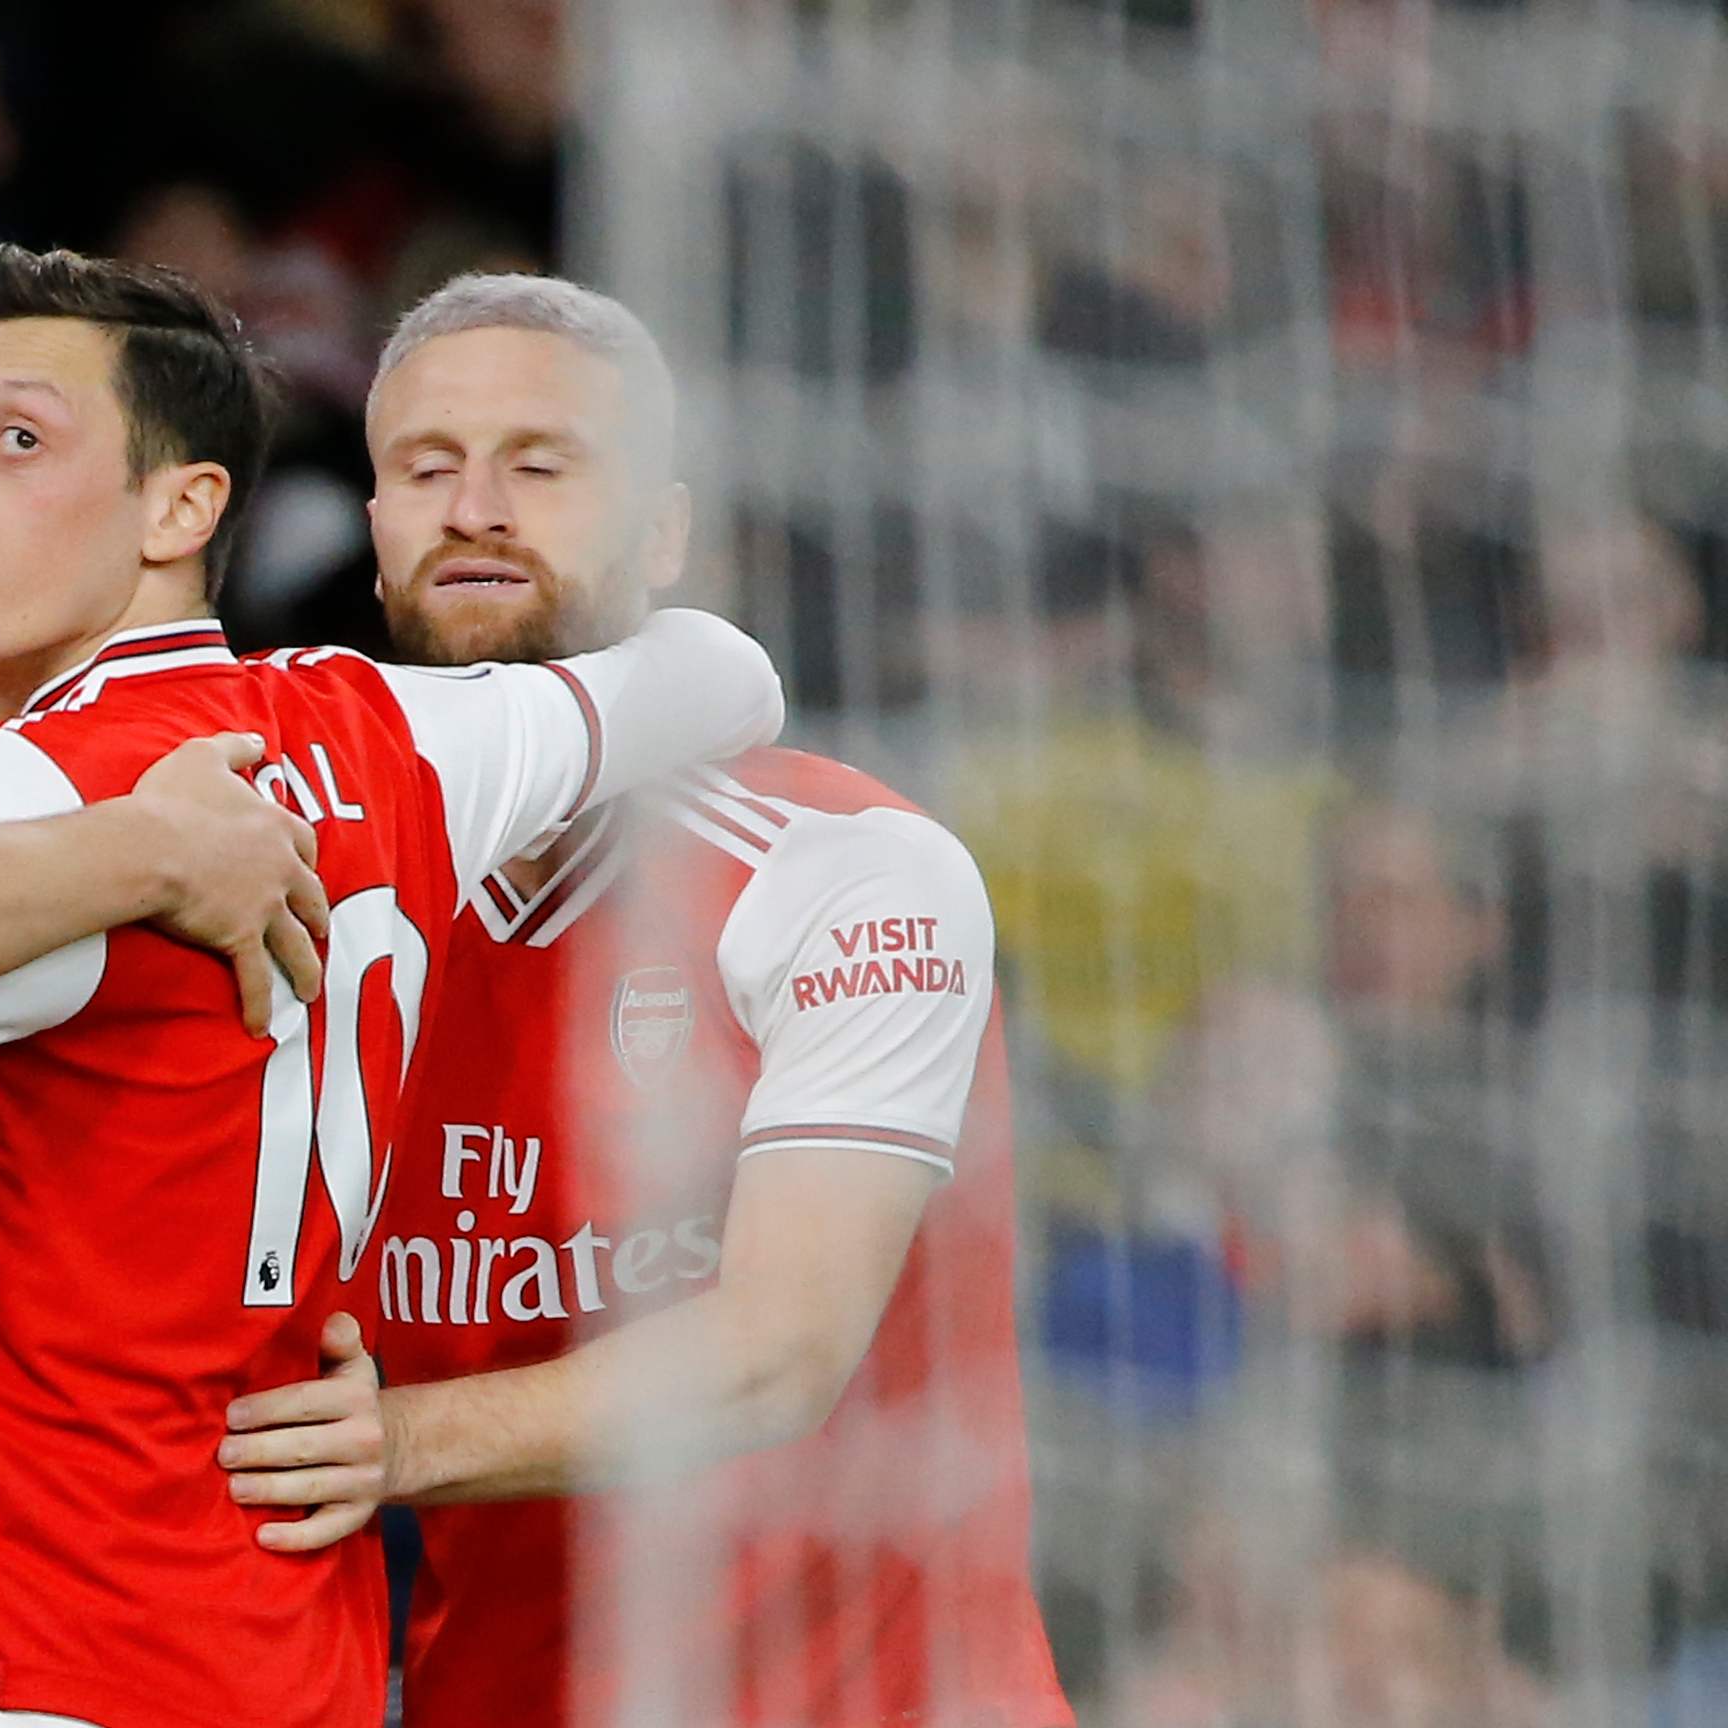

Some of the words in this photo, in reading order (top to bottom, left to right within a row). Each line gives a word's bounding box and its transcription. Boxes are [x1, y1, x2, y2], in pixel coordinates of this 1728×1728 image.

[831, 917, 938, 958] VISIT
[792, 958, 967, 1013] RWANDA
[242, 885, 431, 1309] 10
[441, 1122, 542, 1215] Fly
